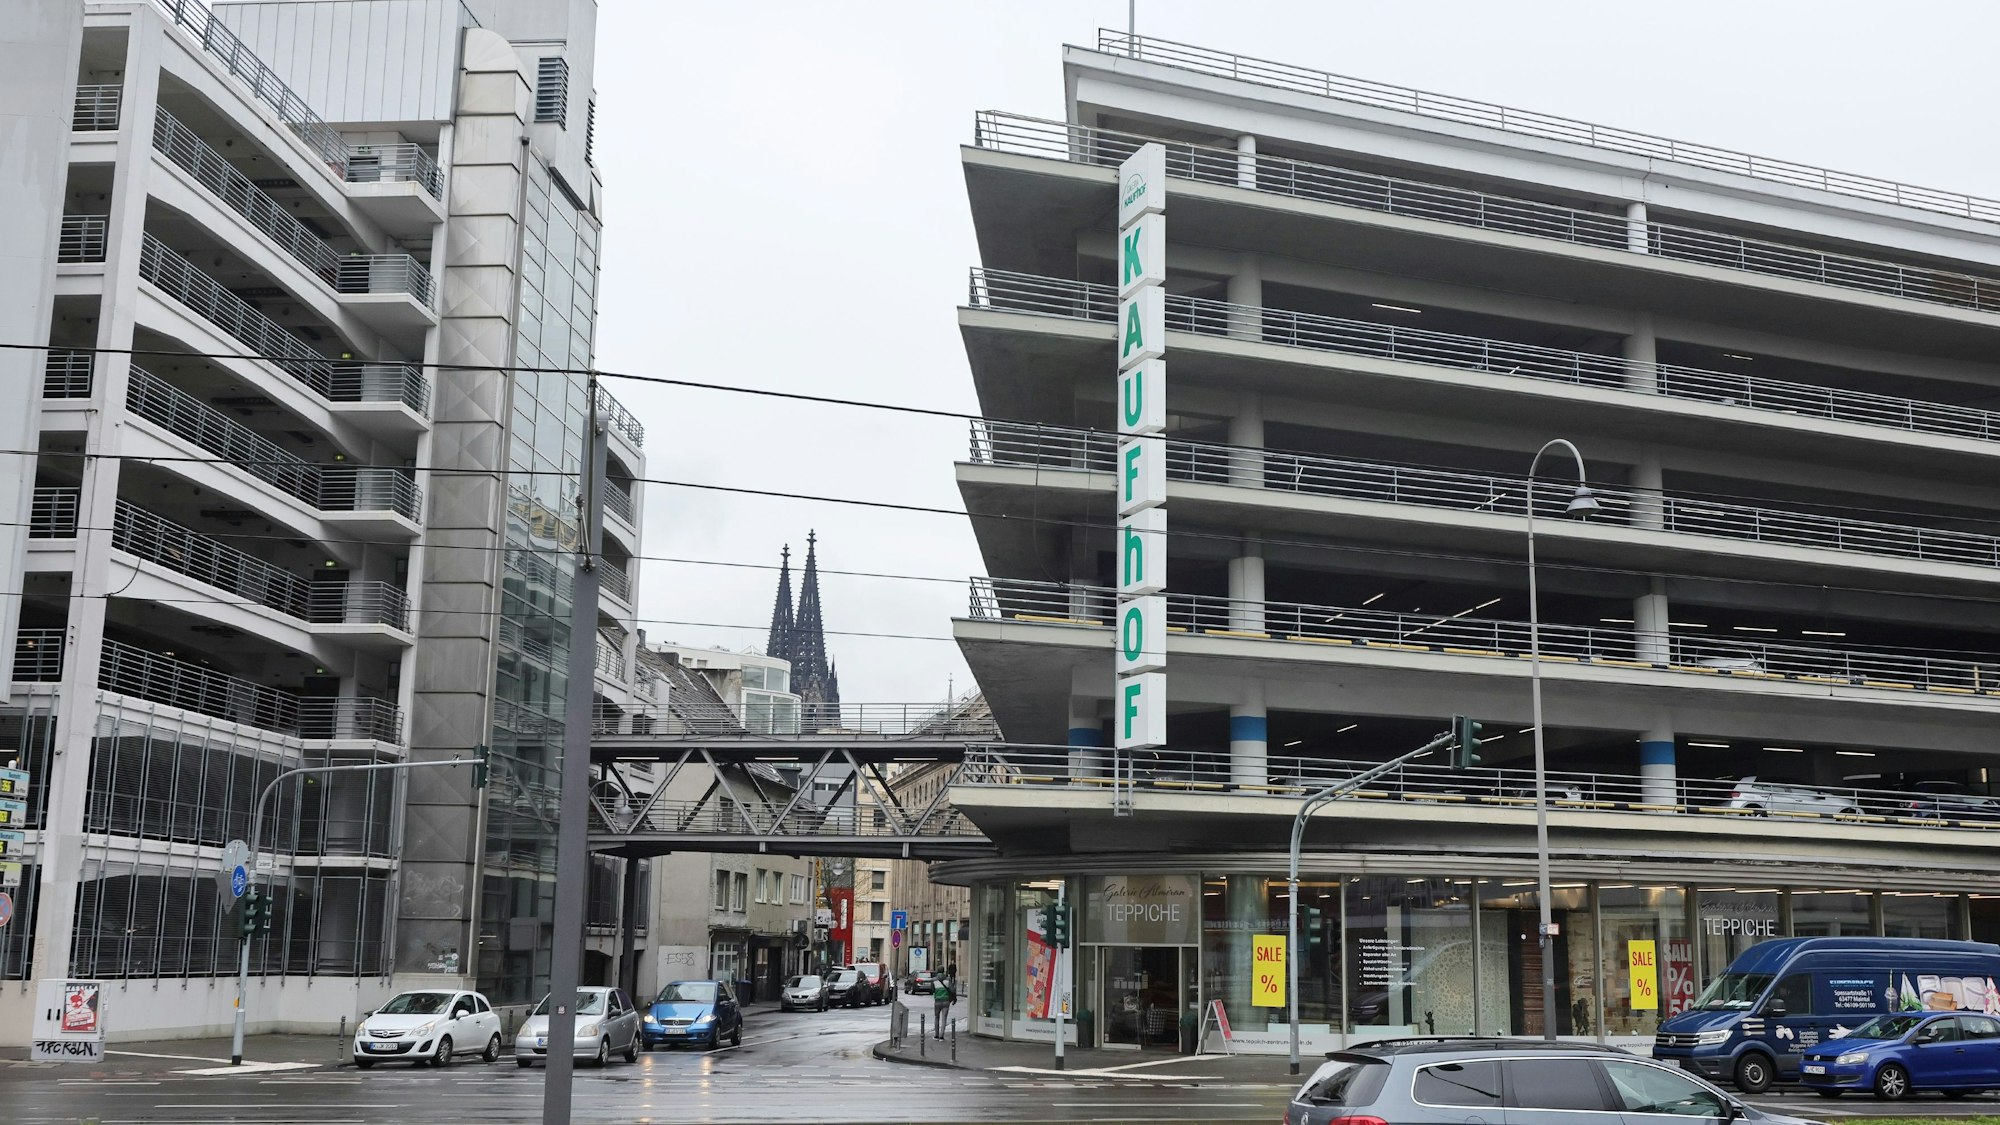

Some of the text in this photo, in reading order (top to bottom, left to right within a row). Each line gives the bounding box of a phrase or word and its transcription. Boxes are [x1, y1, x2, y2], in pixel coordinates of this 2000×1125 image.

[1104, 884, 1136, 902] Galerie
[1106, 903, 1180, 922] TEPPICHE
[1703, 917, 1775, 937] TEPPICHE
[1256, 946, 1282, 962] SALE
[1632, 951, 1653, 966] SALE
[1261, 974, 1278, 993] %
[1636, 978, 1651, 996] %
[1666, 967, 1694, 996] %
